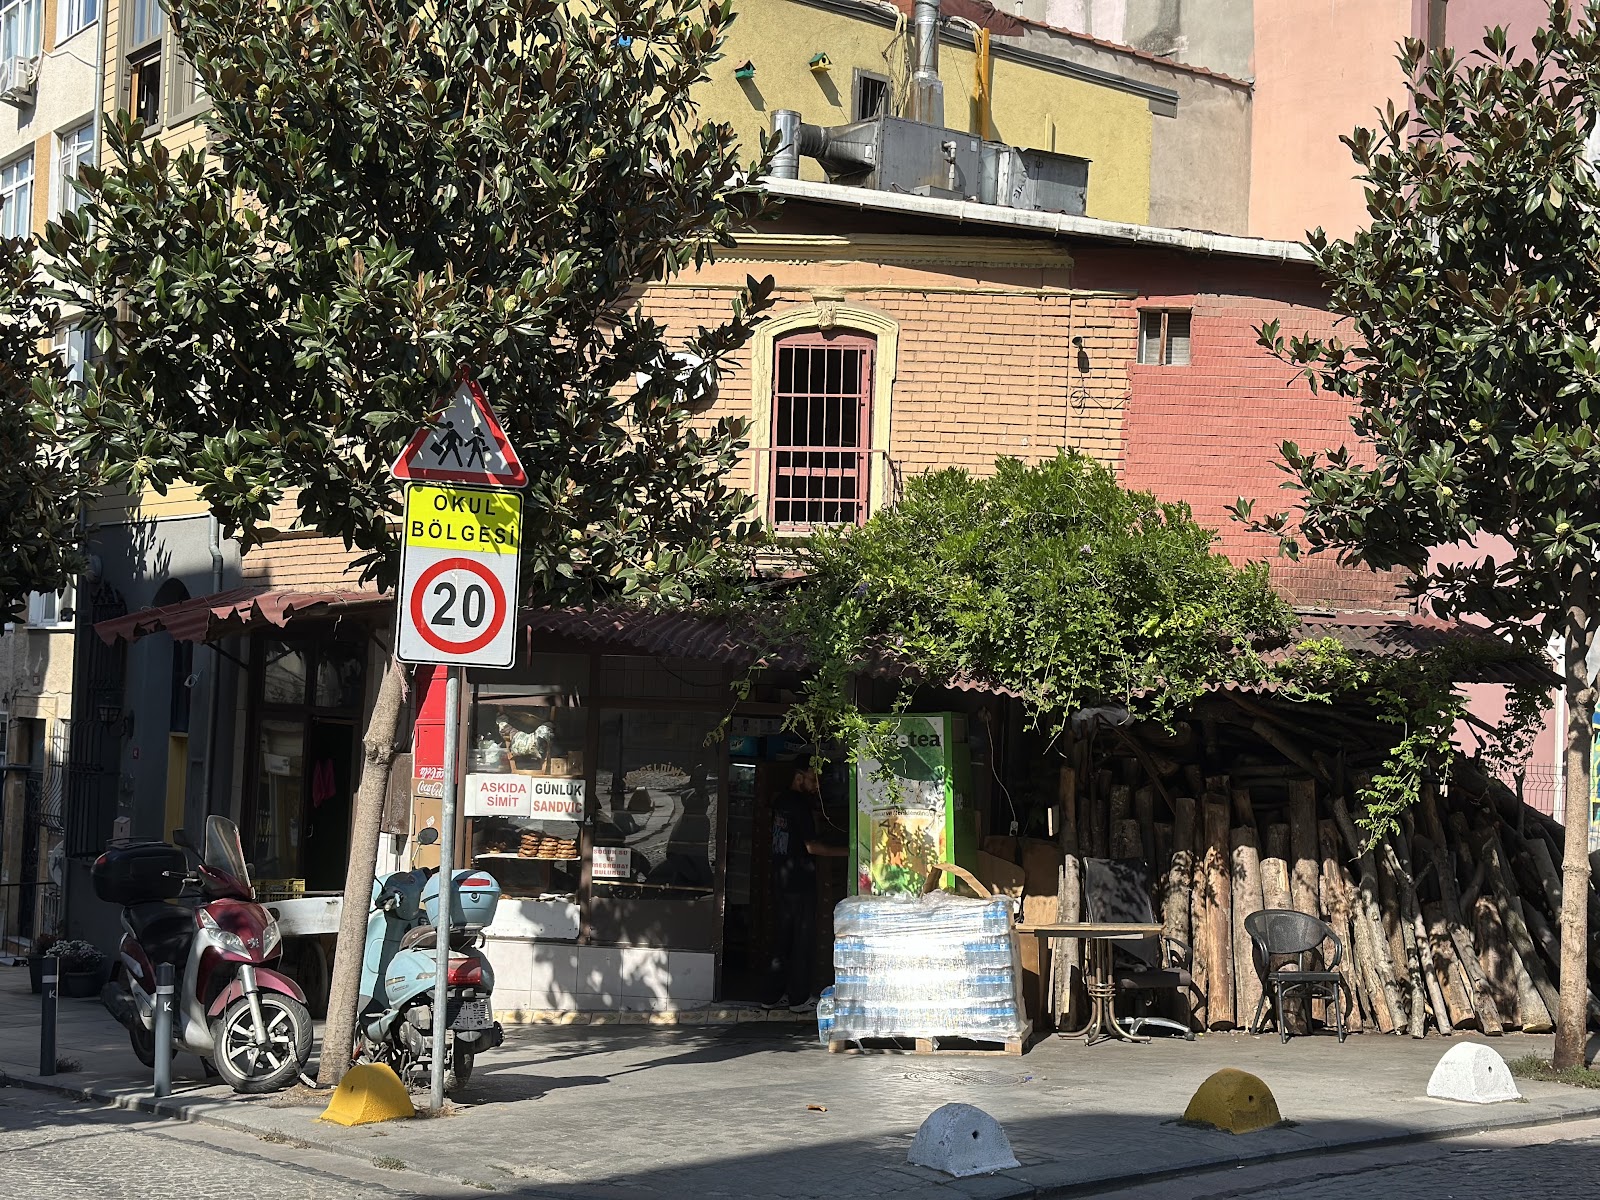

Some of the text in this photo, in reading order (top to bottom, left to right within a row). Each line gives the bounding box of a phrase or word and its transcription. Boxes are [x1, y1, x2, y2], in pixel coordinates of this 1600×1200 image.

[433, 493, 496, 516] OKUL
[411, 518, 516, 545] BÖLGESİ
[430, 581, 486, 628] 20
[480, 782, 527, 794] ASKIDA
[535, 781, 583, 796] GÜNLÜK
[486, 794, 520, 807] SİMİT
